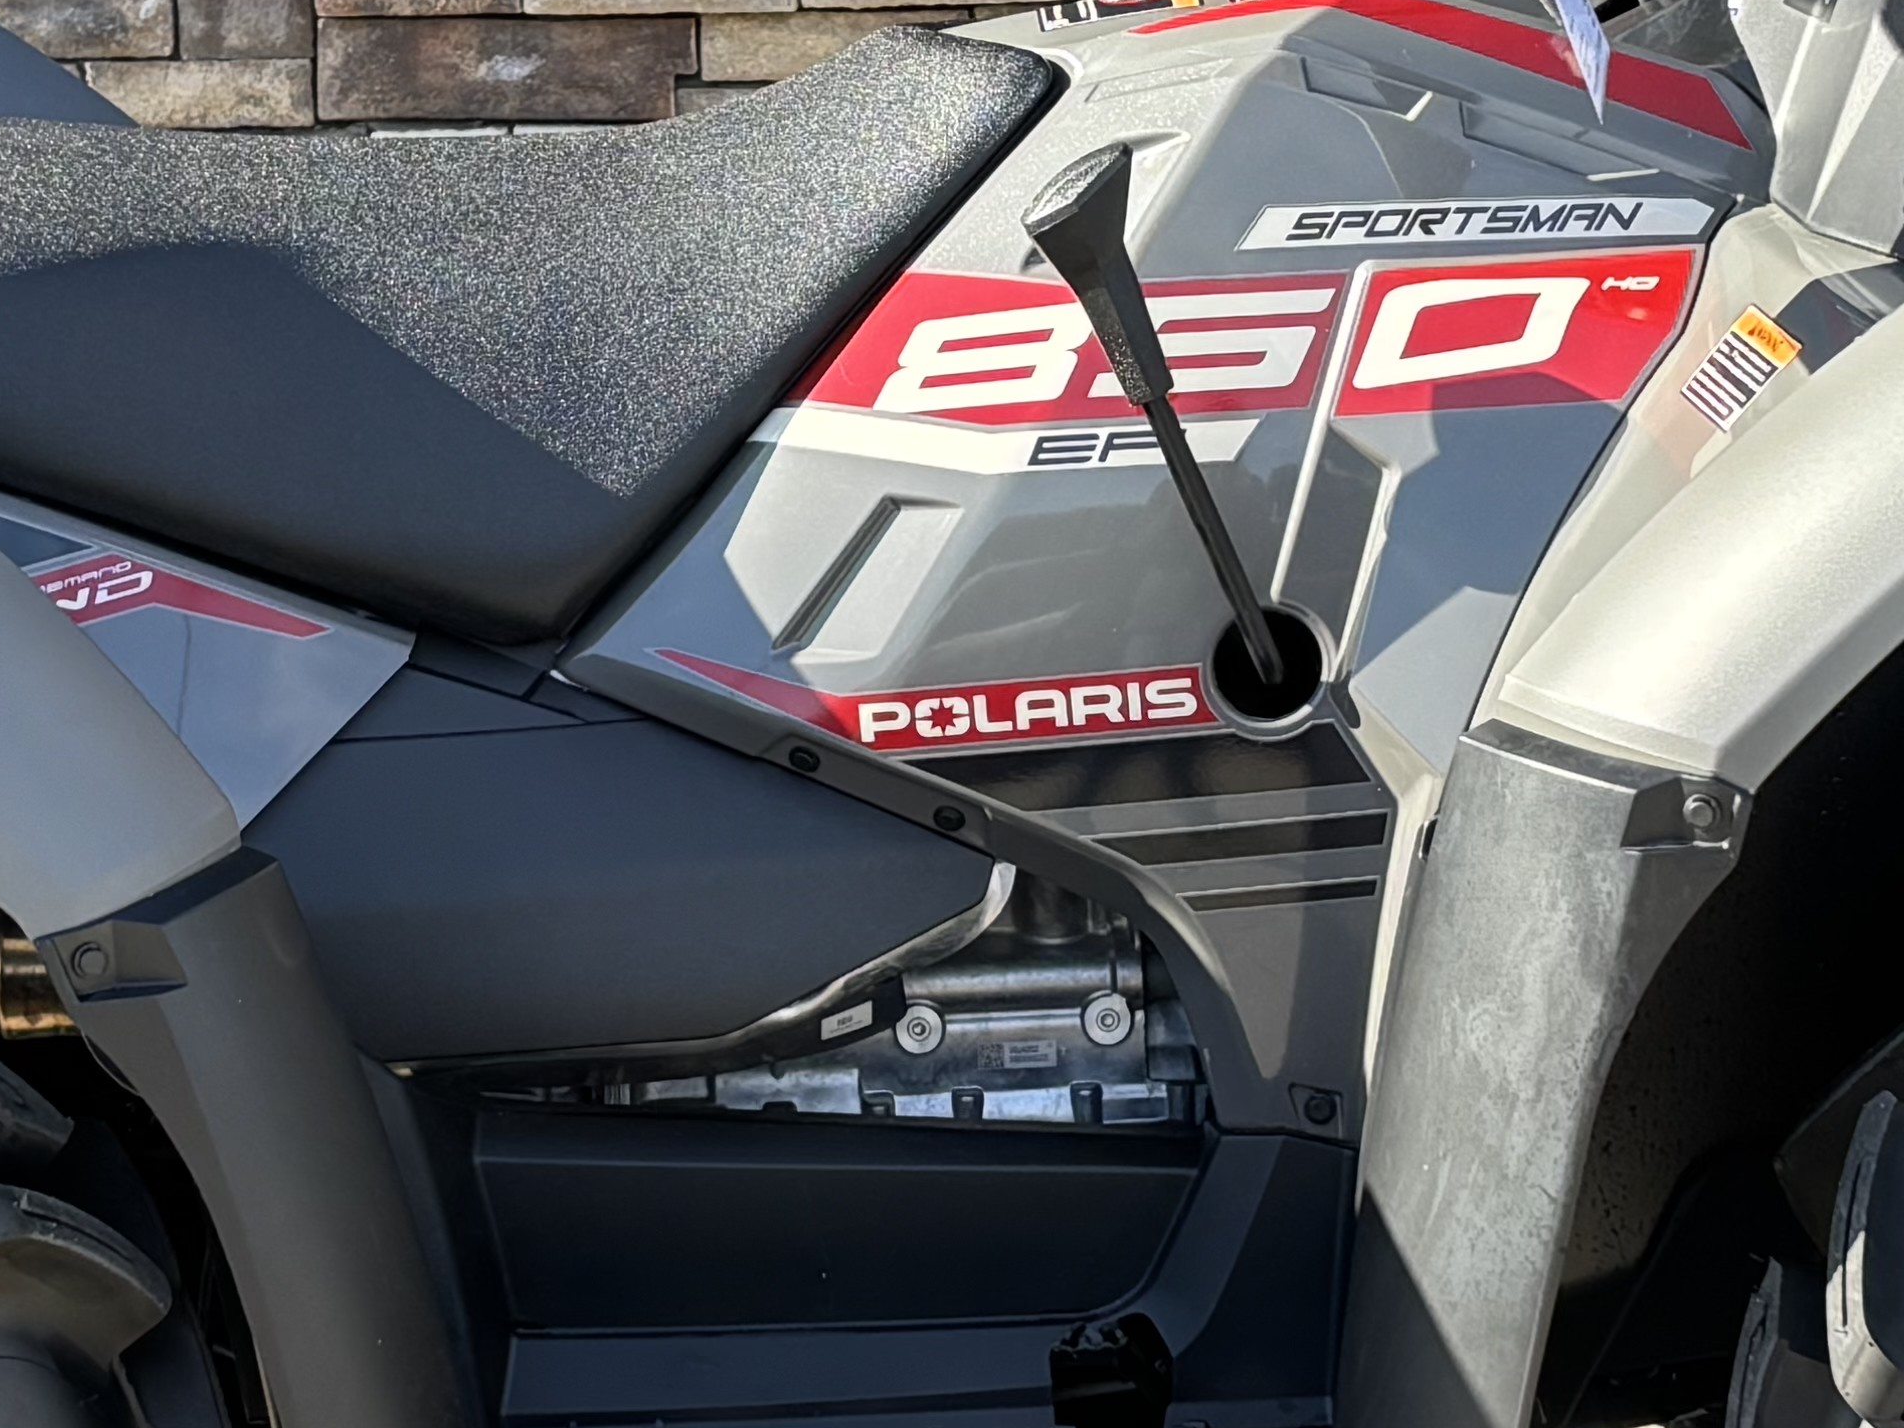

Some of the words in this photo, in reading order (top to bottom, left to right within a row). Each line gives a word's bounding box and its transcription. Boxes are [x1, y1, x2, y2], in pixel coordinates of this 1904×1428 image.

[1285, 201, 1644, 241] SPORTSMAN
[872, 276, 1591, 415] 850
[1600, 275, 1660, 292] HO
[1027, 426, 1188, 467] EF
[857, 676, 1198, 744] POLARIS
